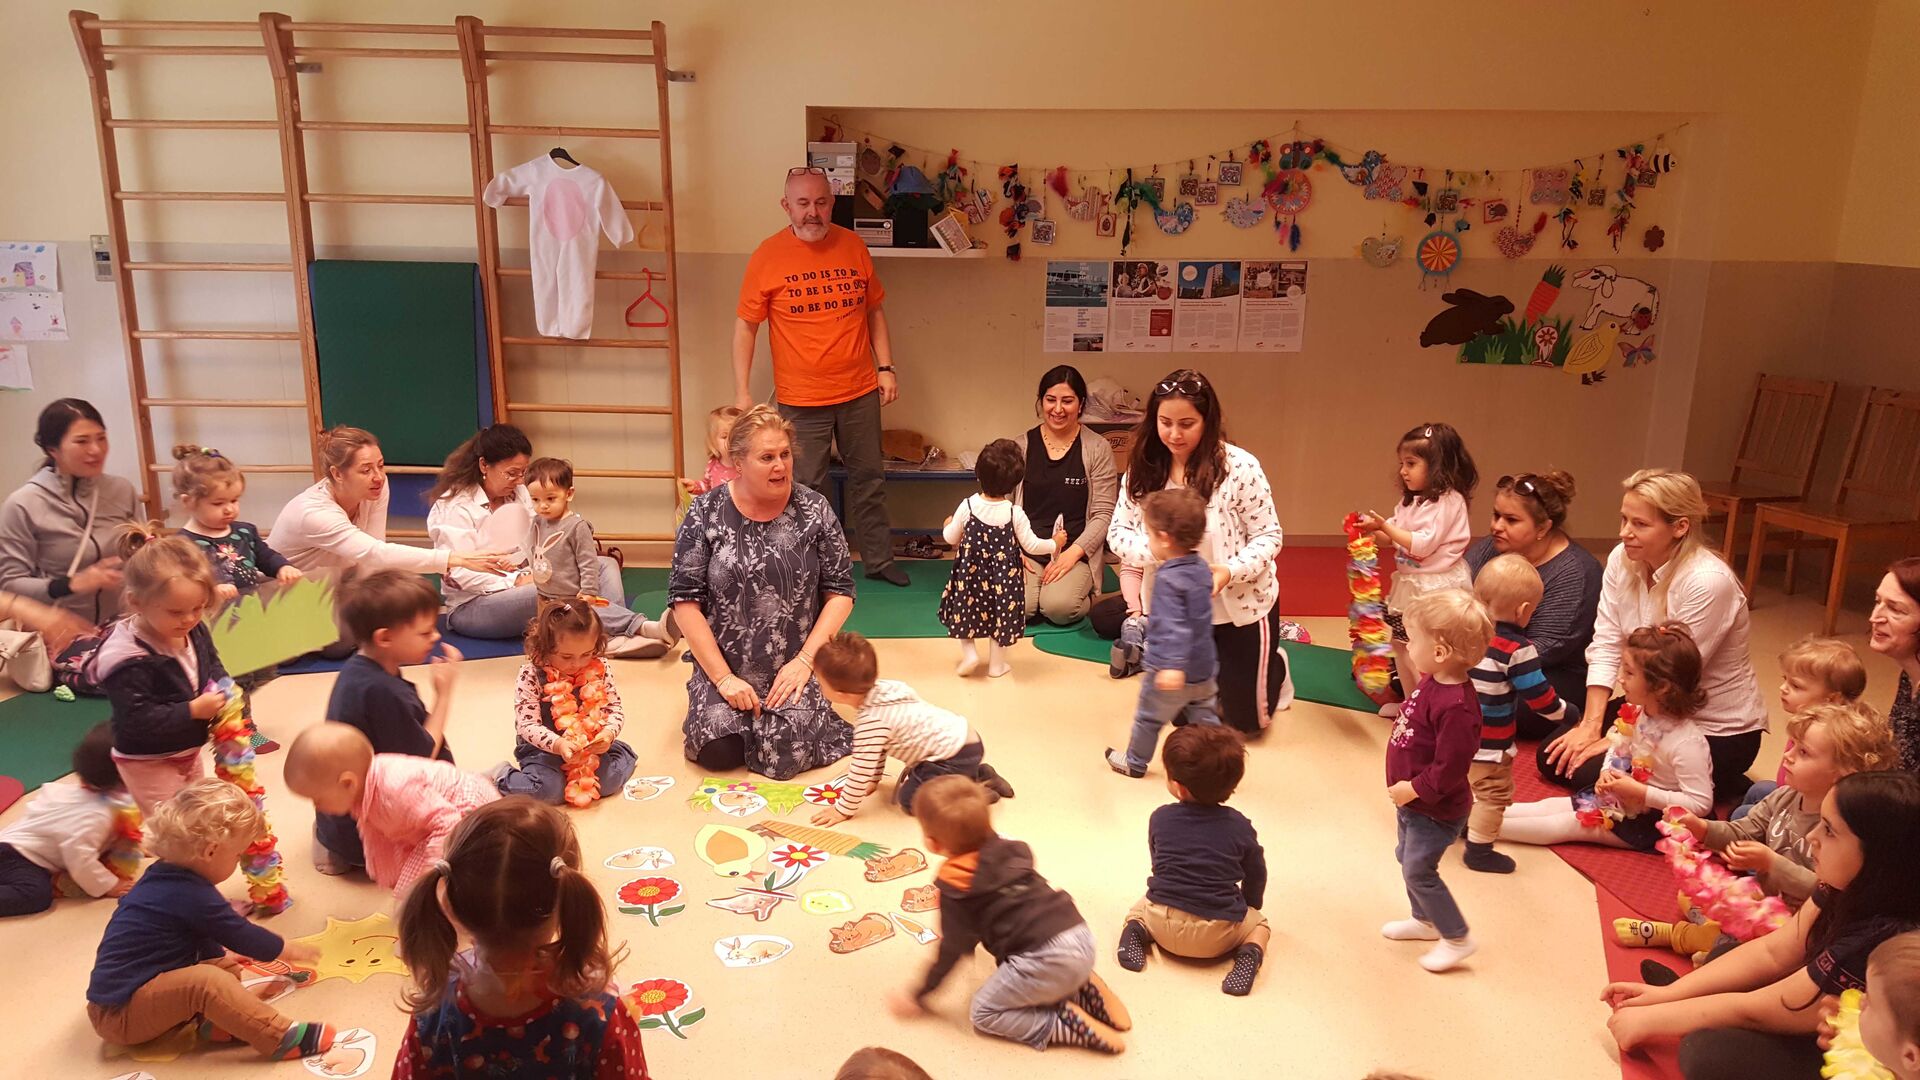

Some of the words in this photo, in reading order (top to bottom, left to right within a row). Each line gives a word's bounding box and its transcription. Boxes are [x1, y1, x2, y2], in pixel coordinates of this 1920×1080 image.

[785, 274, 799, 283] TO
[802, 272, 817, 281] DO
[820, 270, 831, 279] IS
[834, 268, 847, 277] TO
[788, 289, 802, 298] TO
[806, 287, 820, 296] BE
[823, 285, 833, 294] IS
[837, 282, 851, 292] TO
[790, 305, 804, 314] DO
[808, 303, 821, 312] BE
[824, 300, 838, 310] DO
[842, 298, 854, 308] BE
